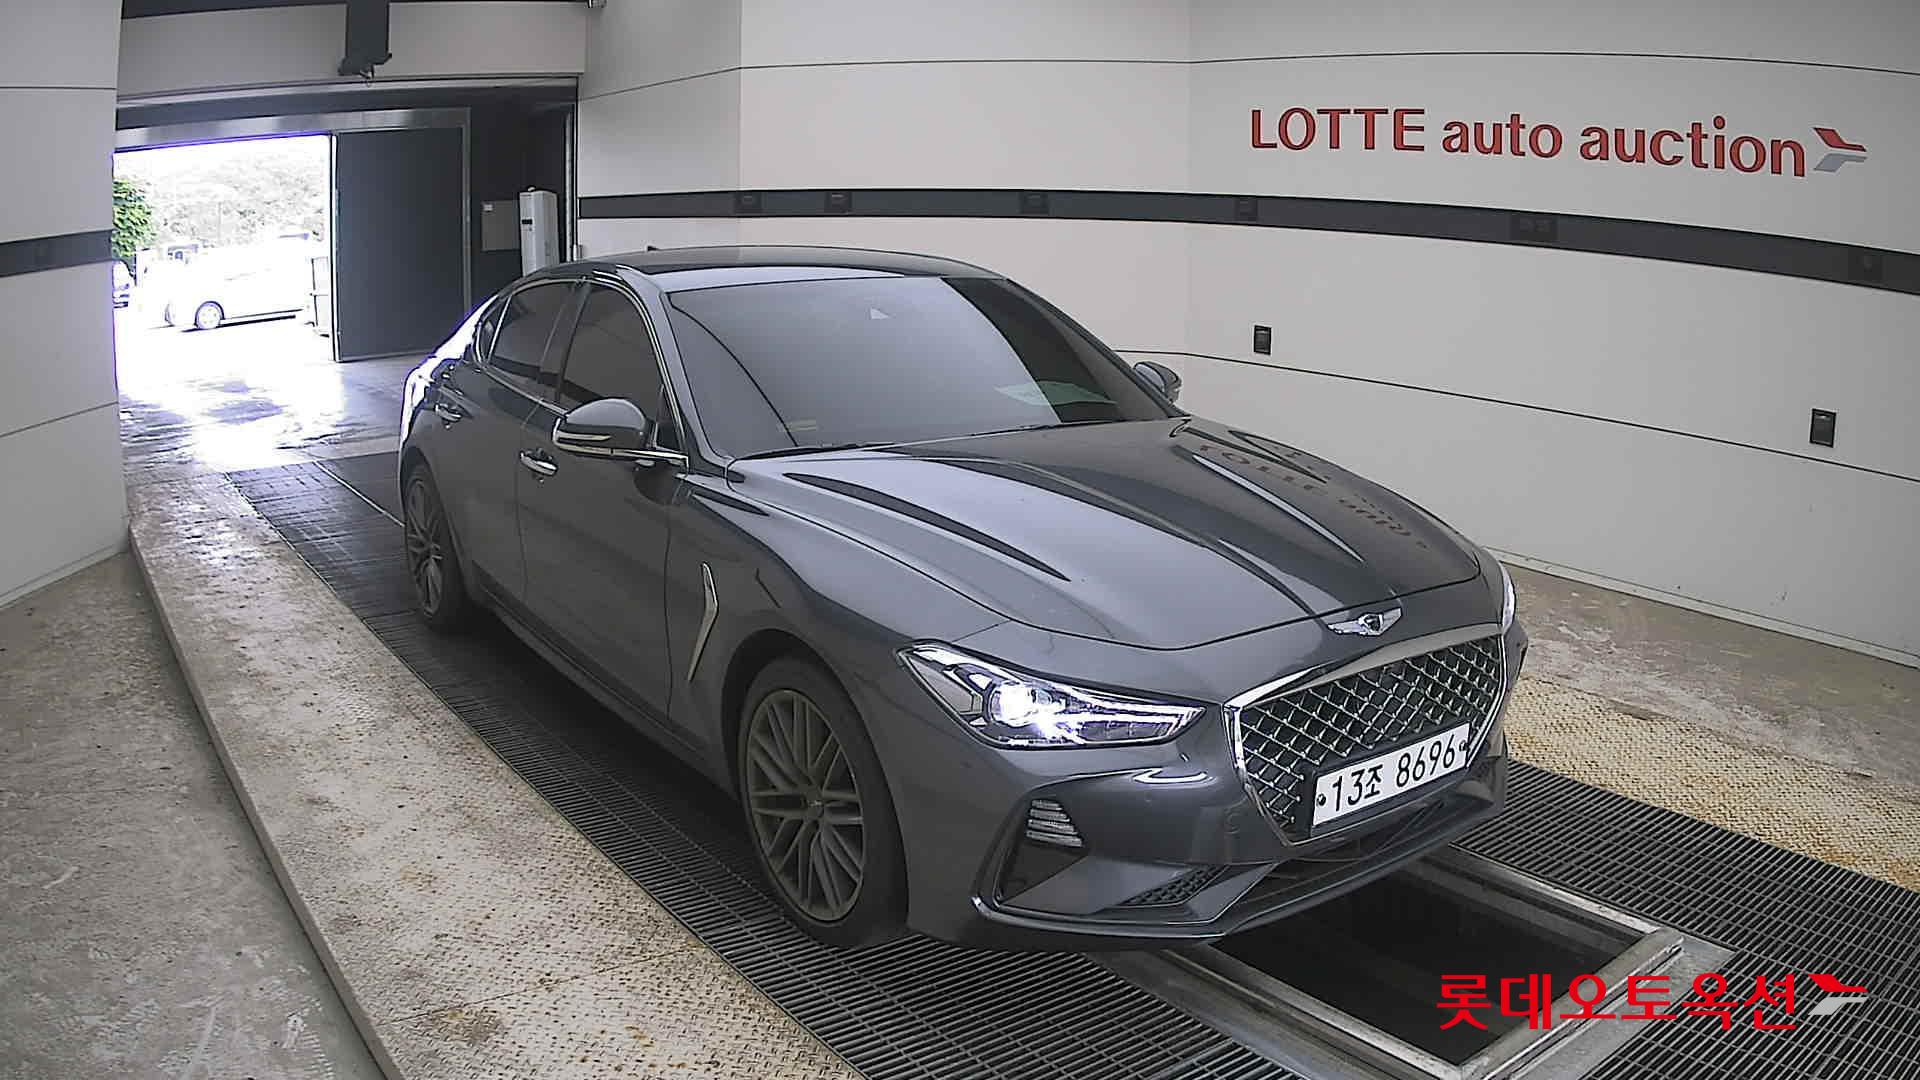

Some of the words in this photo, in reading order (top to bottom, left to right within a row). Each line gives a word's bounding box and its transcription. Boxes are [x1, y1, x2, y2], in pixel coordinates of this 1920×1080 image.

[1251, 107, 1425, 151] LOTTE
[1442, 113, 1564, 158] auto
[1579, 115, 1807, 177] auction
[1332, 764, 1383, 812] 13조
[1396, 734, 1456, 788] 8696
